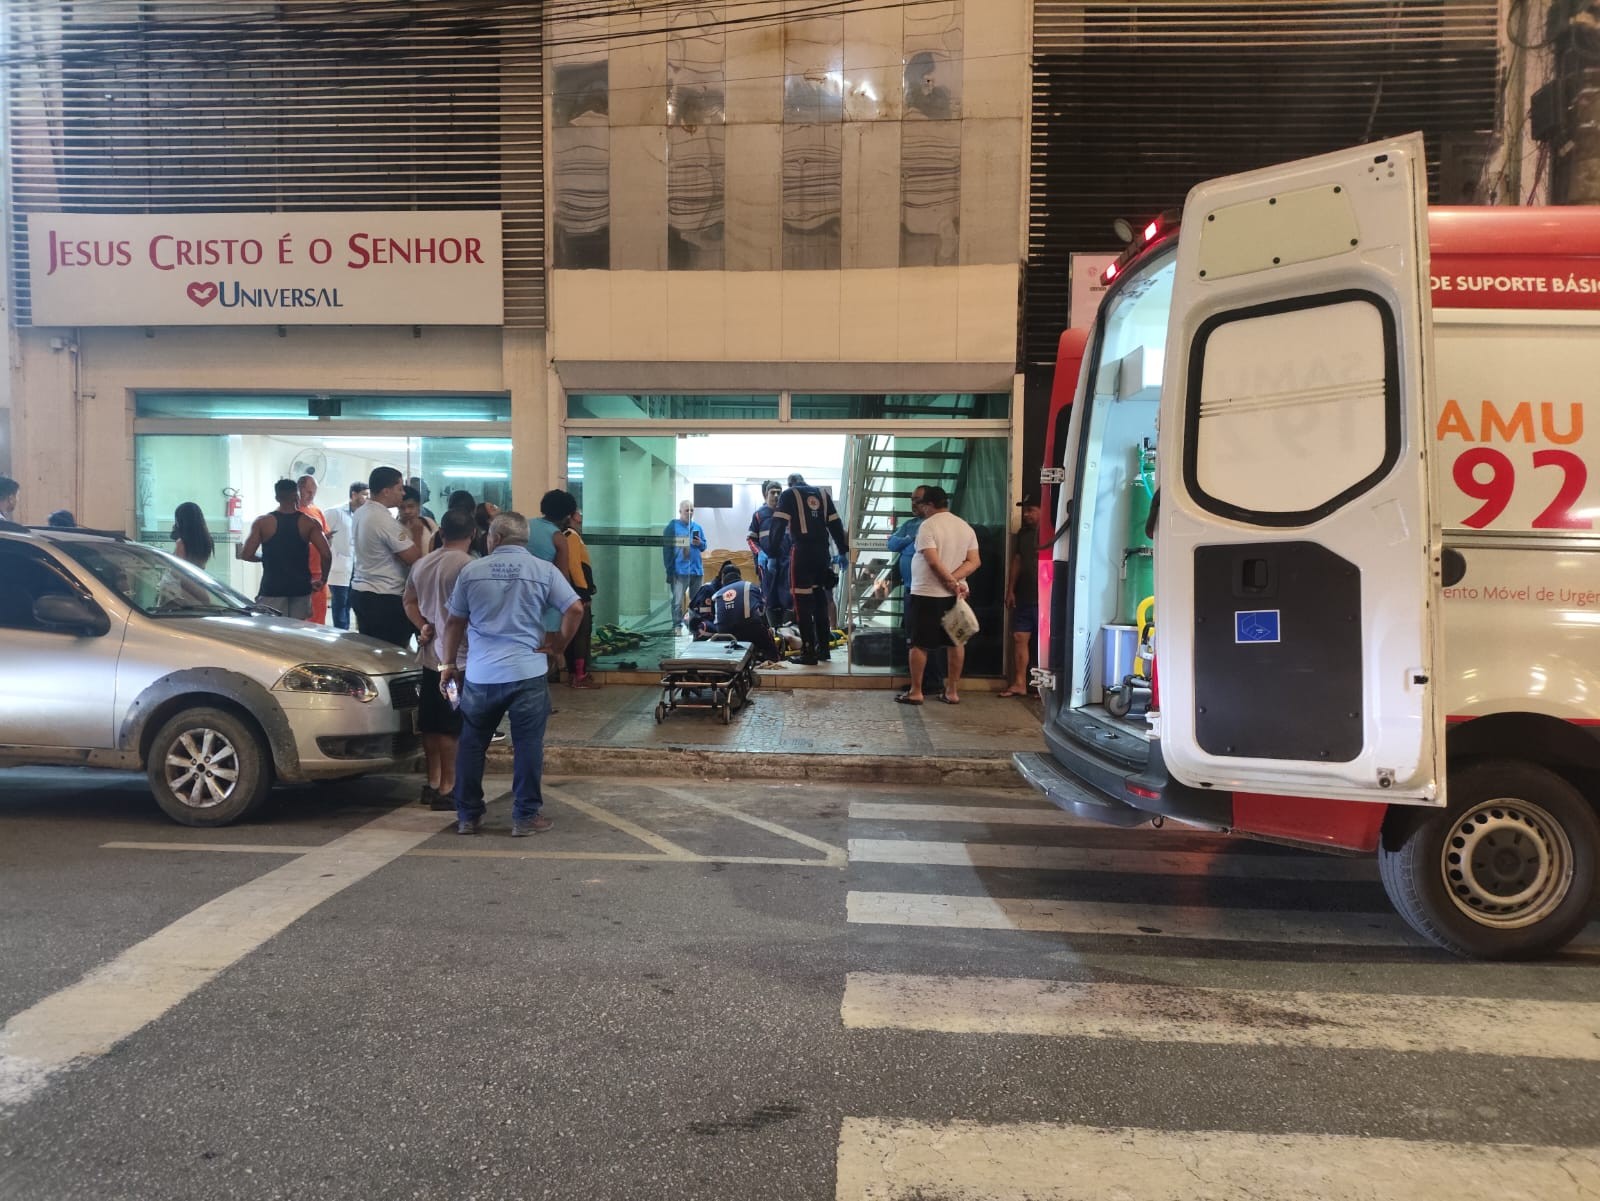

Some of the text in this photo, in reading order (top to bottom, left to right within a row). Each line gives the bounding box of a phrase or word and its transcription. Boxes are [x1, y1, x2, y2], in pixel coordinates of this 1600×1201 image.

[278, 232, 294, 264] É
[309, 237, 333, 265] O
[1431, 272, 1600, 294] DE SUPORTE BÁSI
[1437, 399, 1583, 445] AMU
[1452, 447, 1593, 529] 92
[1443, 587, 1478, 599] ento
[1483, 586, 1530, 600] Móvel
[1536, 587, 1554, 601] de
